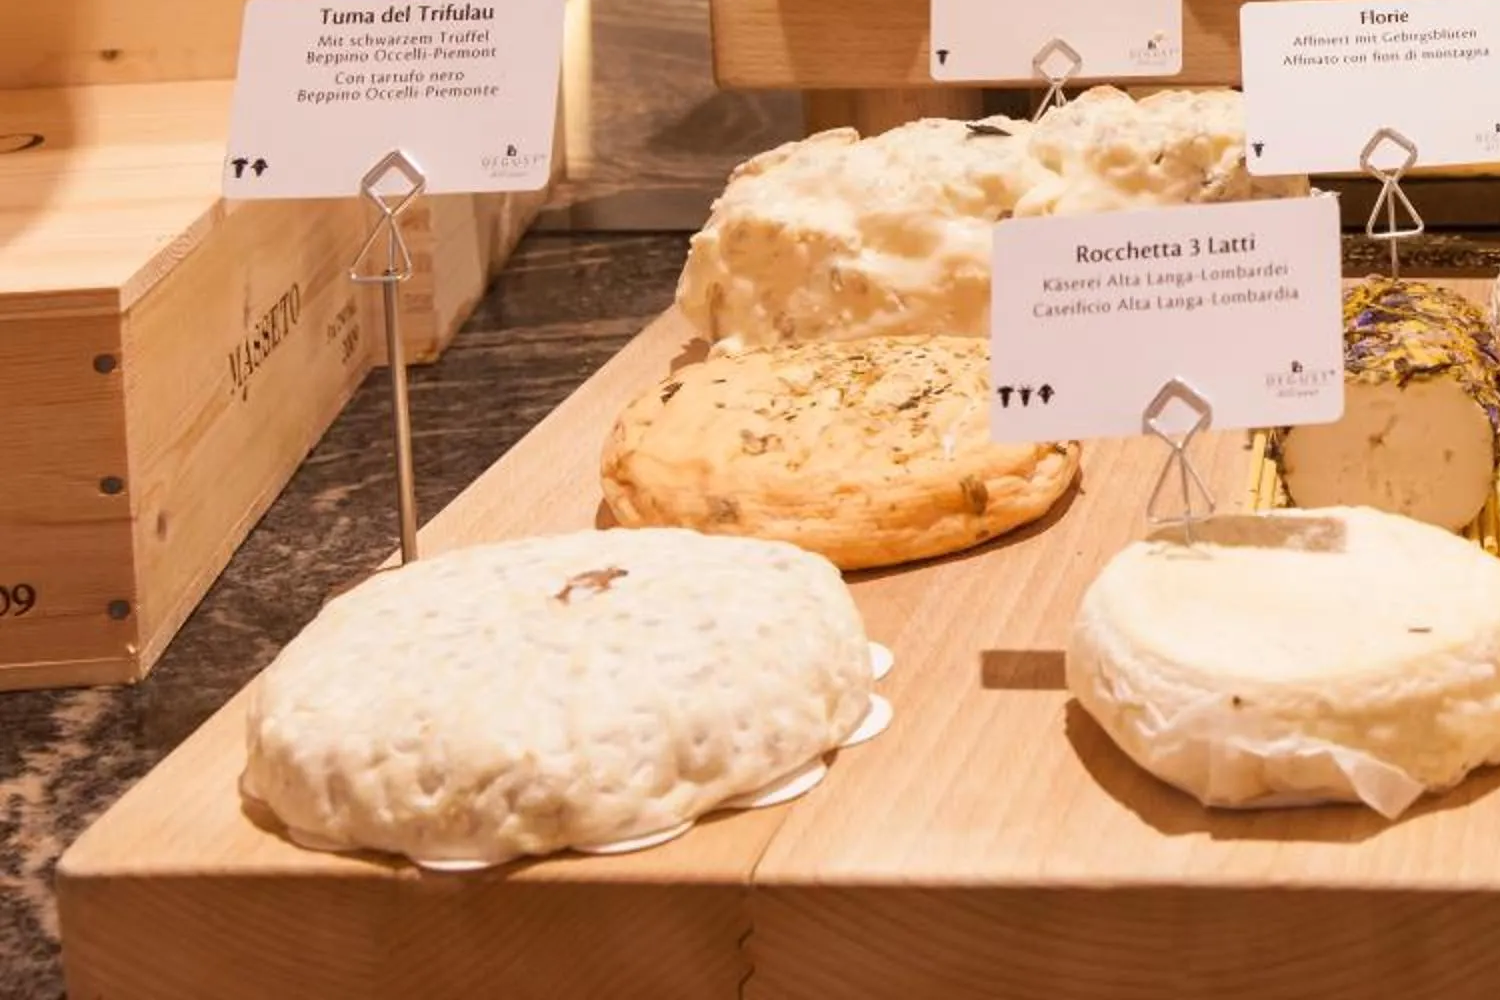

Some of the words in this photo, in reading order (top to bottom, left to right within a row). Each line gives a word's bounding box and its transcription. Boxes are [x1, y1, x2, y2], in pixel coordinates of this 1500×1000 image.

[320, 8, 374, 25] Tuma
[381, 7, 410, 23] del
[418, 5, 494, 22] Trifulau
[1360, 10, 1408, 25] Florie
[318, 35, 344, 48] Mit
[350, 33, 433, 47] schwarzem
[1355, 34, 1377, 44] mit
[306, 51, 369, 66] Beppino
[1283, 54, 1339, 66] Affinato
[1343, 55, 1367, 64] con
[1405, 51, 1417, 61] di
[1422, 47, 1489, 61] montagna
[335, 72, 365, 84] Con
[370, 70, 425, 84] tartufo
[430, 71, 465, 82] nero
[297, 89, 360, 104] Beppino
[1076, 240, 1182, 263] Rocchetta
[1189, 238, 1200, 256] 3
[1208, 234, 1256, 254] Latti
[1043, 275, 1101, 292] Käserei
[1107, 273, 1140, 288] Alta
[1033, 299, 1111, 318] Caseificio
[1117, 296, 1150, 312] Alta
